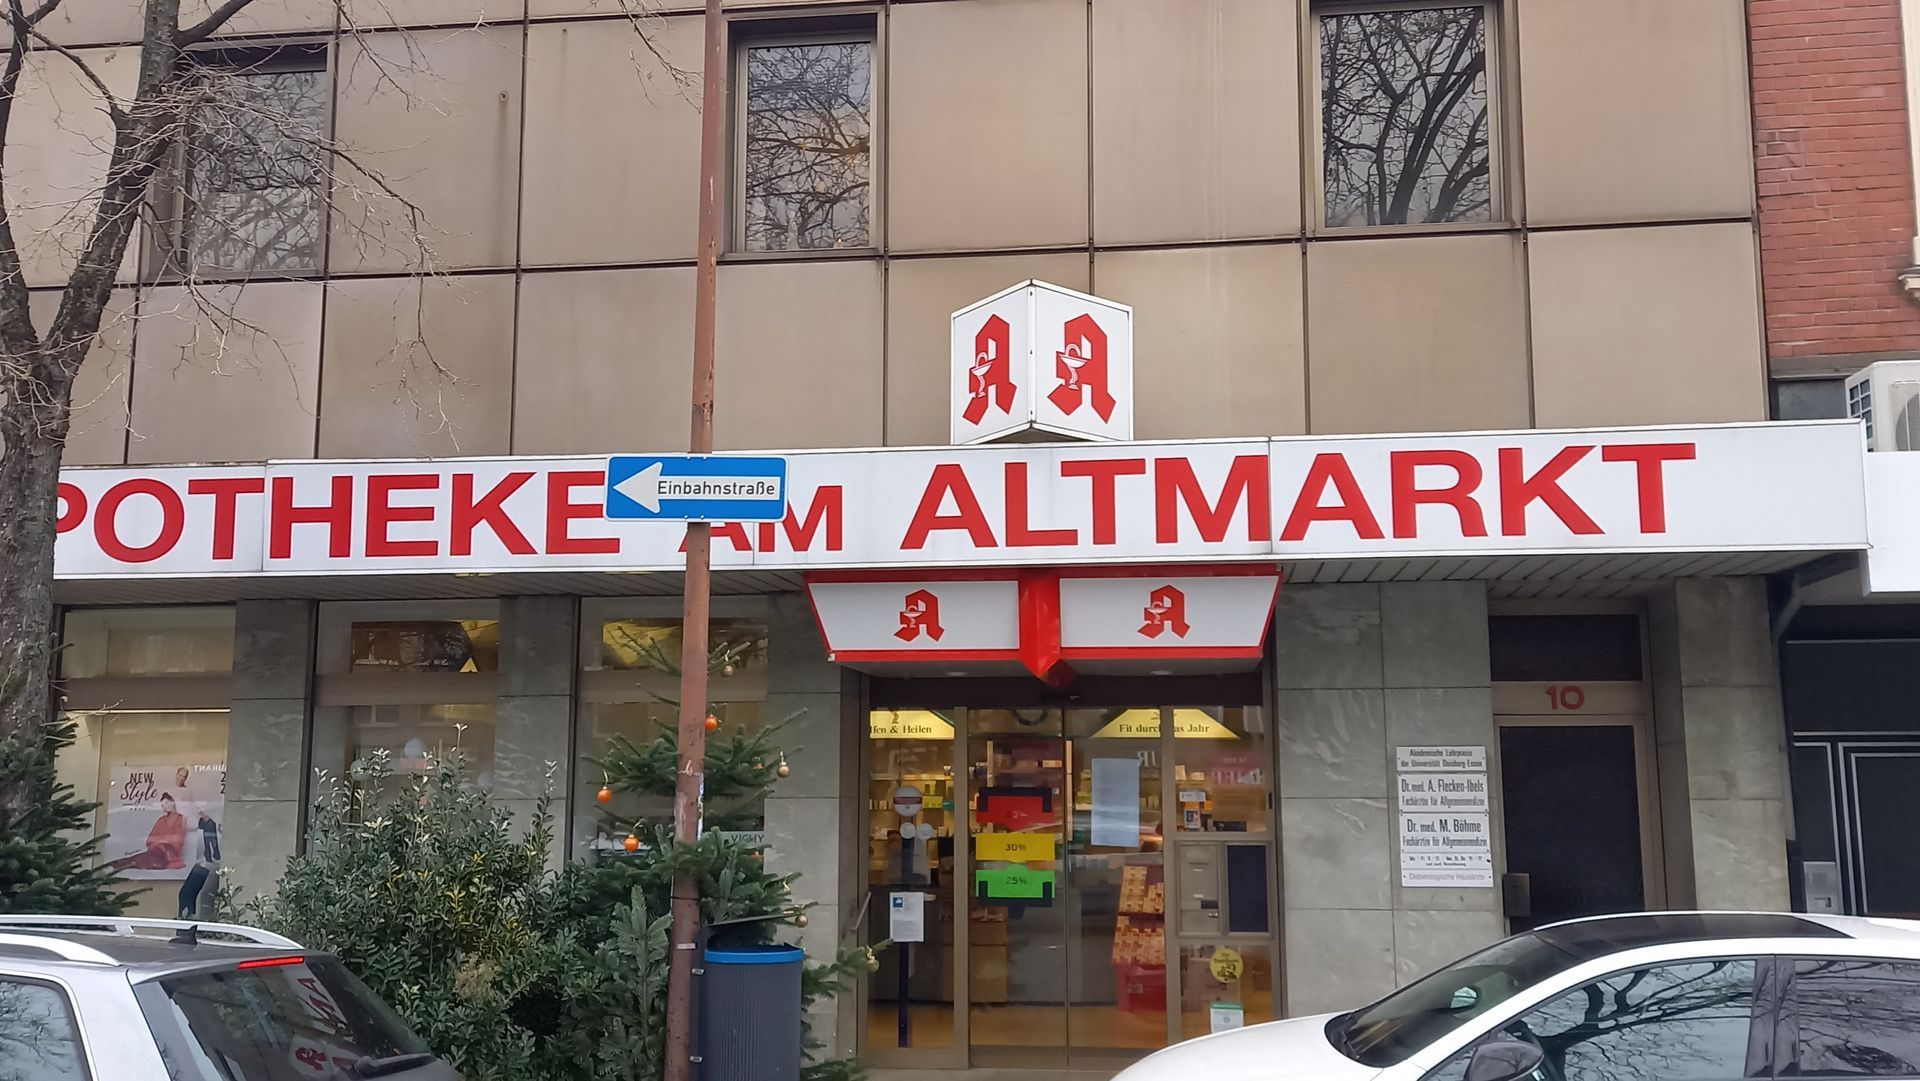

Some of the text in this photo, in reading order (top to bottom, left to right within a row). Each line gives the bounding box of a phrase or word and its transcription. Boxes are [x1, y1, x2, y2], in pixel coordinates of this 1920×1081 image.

[657, 480, 775, 496] Einbahnstraße
[899, 443, 1697, 550] ALTMARKT
[1545, 686, 1585, 710] 10
[889, 725, 898, 734] &
[902, 725, 932, 734] Heilen
[1119, 723, 1132, 733] Fit
[1187, 723, 1210, 733] Jahr
[130, 772, 154, 784] NEW
[1401, 779, 1411, 792] Dr.
[120, 780, 159, 806] Style
[1407, 818, 1482, 832] Dr. med. M. Böhme
[1005, 843, 1027, 852] 30%
[1006, 876, 1028, 885] 25%
